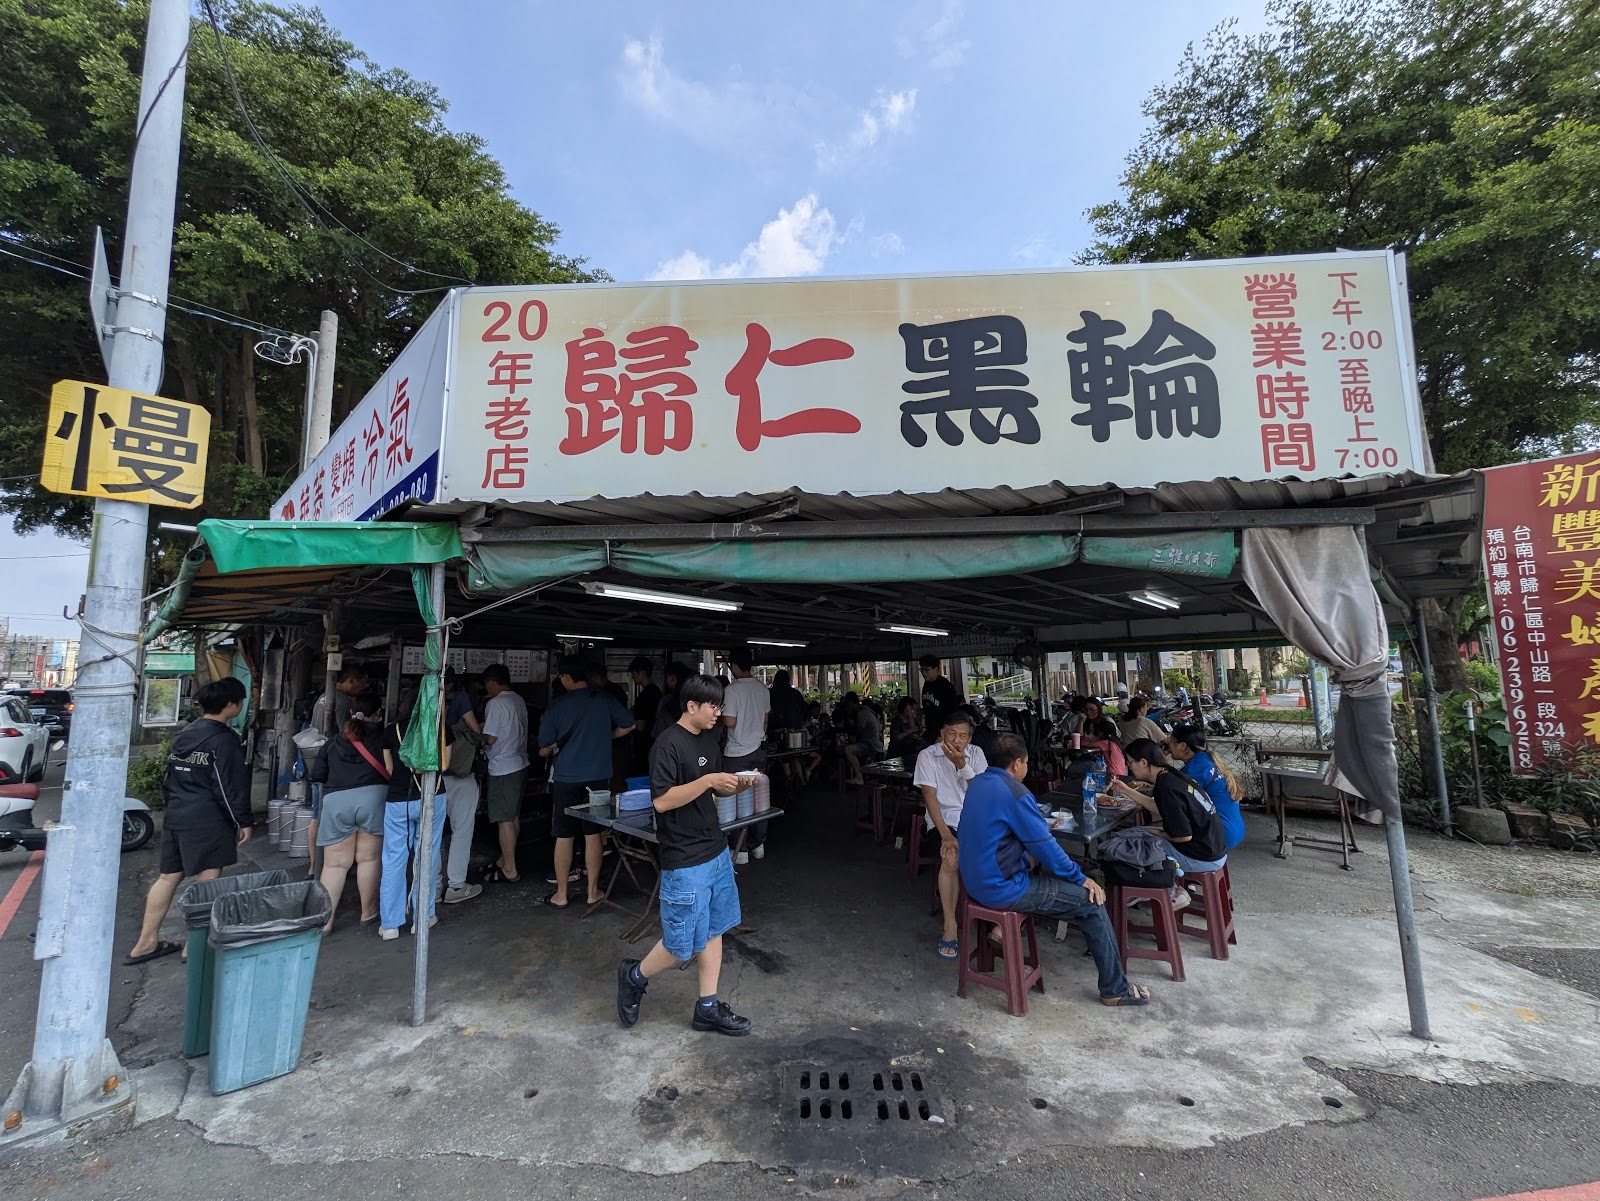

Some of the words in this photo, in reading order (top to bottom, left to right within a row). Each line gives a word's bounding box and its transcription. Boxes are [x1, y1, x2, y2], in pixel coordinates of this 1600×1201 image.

[54, 386, 199, 503] 慢
[360, 376, 414, 497] 冷氣
[481, 299, 549, 489] 20年老店
[558, 308, 1222, 456] 歸仁黑輪
[1243, 271, 1316, 474] 營業時間
[1320, 271, 1400, 469] 下午2:00至晚上7:00
